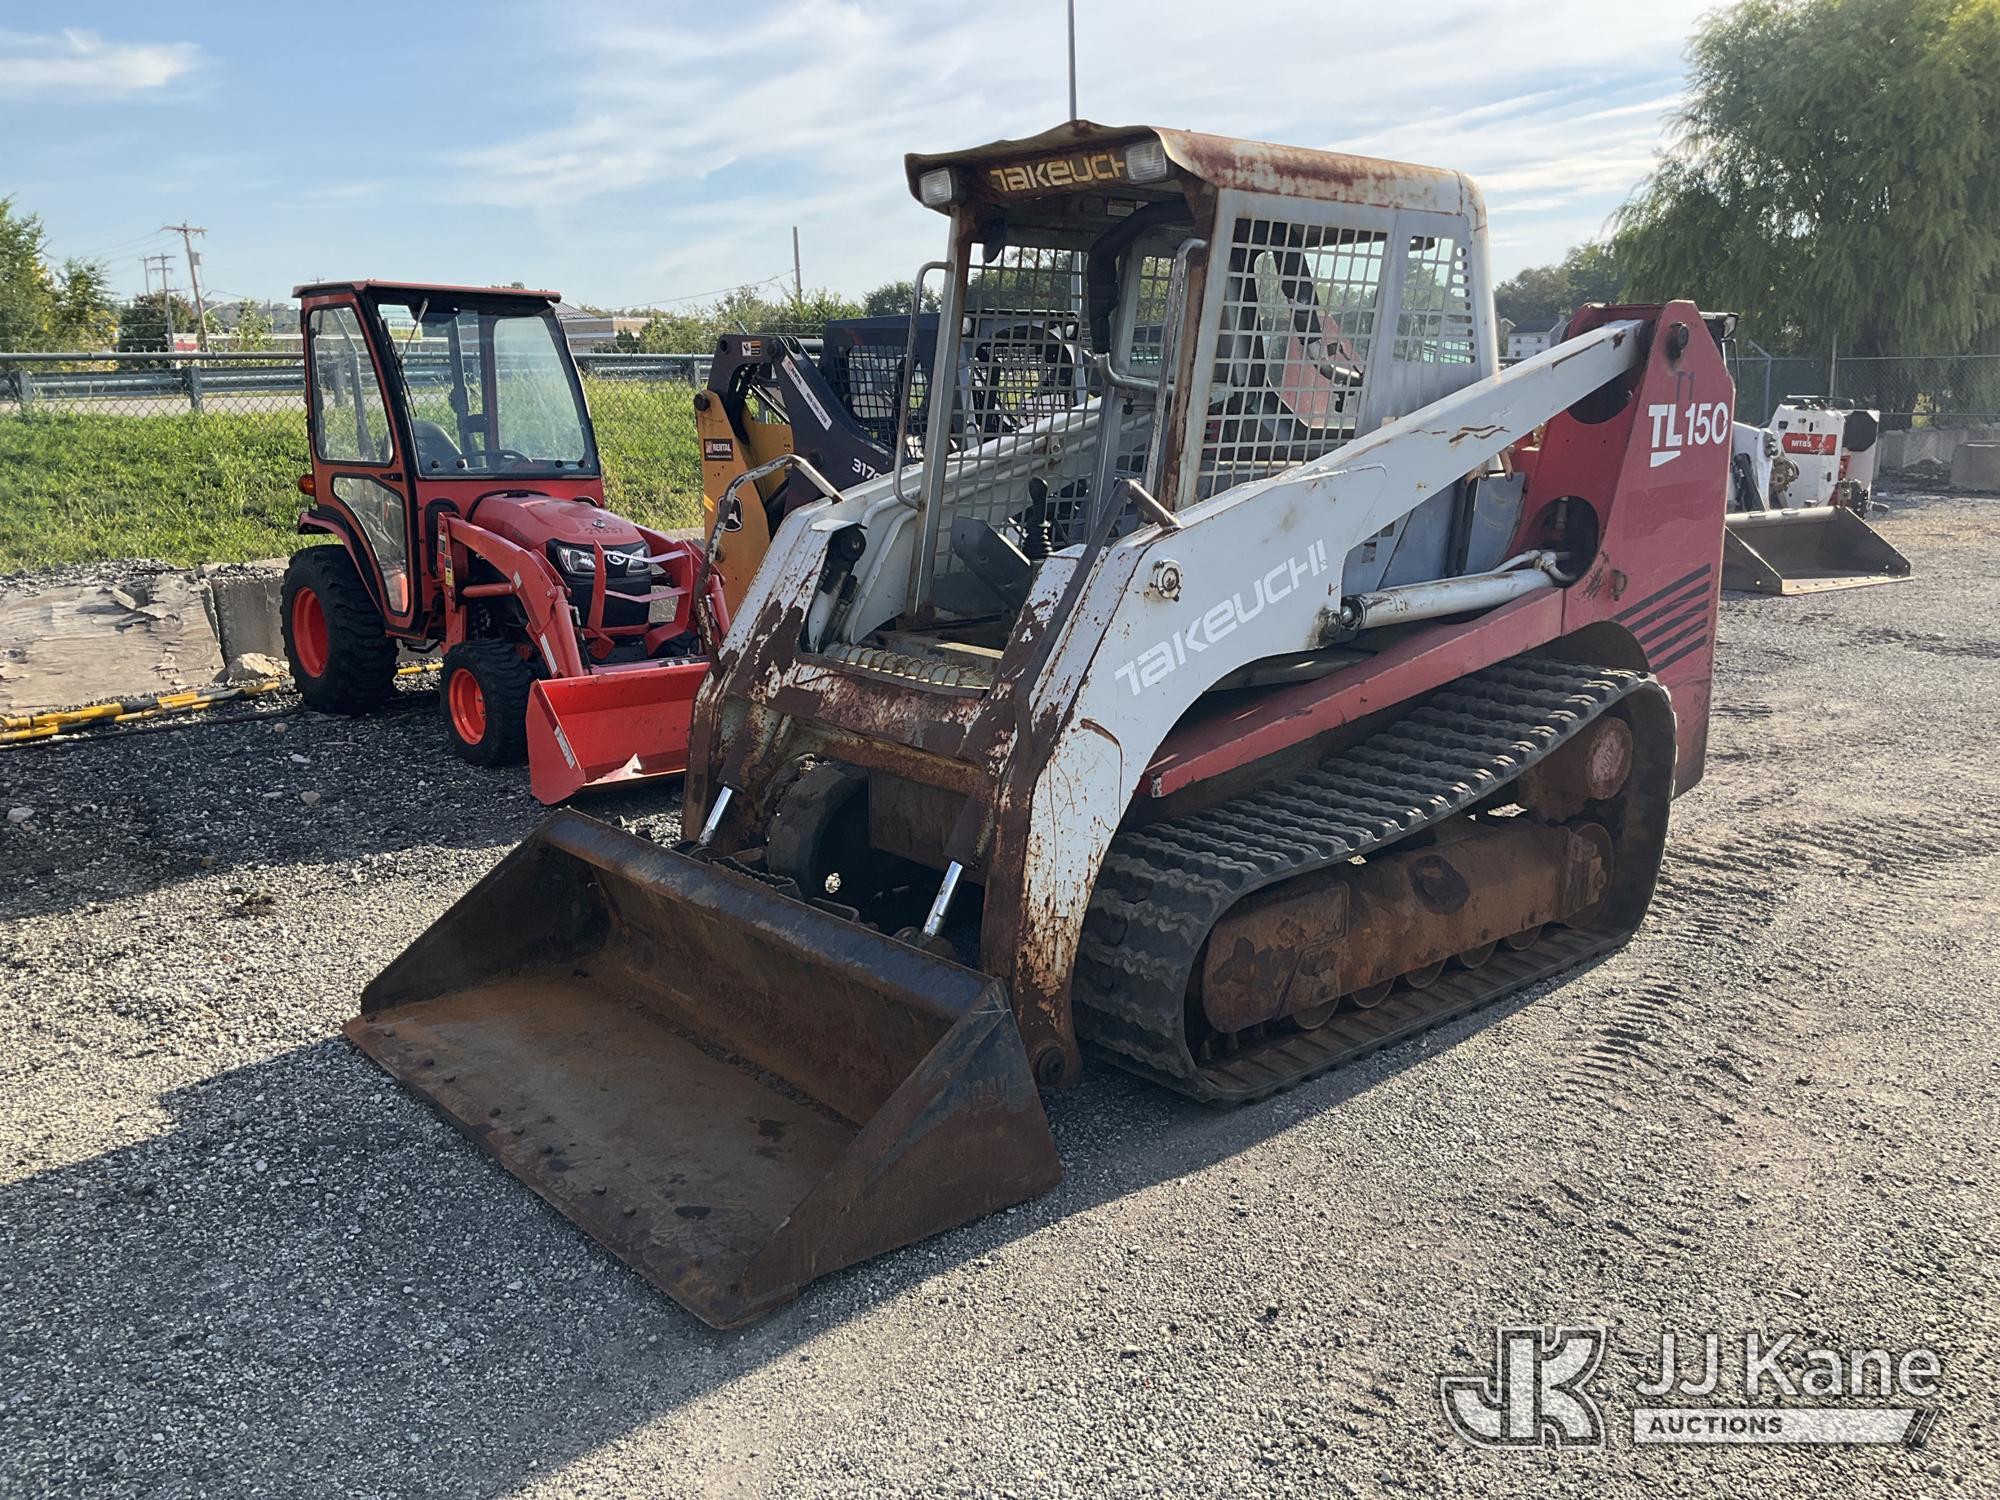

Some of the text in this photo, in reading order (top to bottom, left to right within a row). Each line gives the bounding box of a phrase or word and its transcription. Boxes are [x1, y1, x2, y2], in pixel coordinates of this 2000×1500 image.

[990, 153, 1125, 193] TAKEUCH
[1648, 402, 1729, 448] TL150
[712, 443, 732, 452] RENTAL
[1114, 538, 1328, 697] TAKEUCHI
